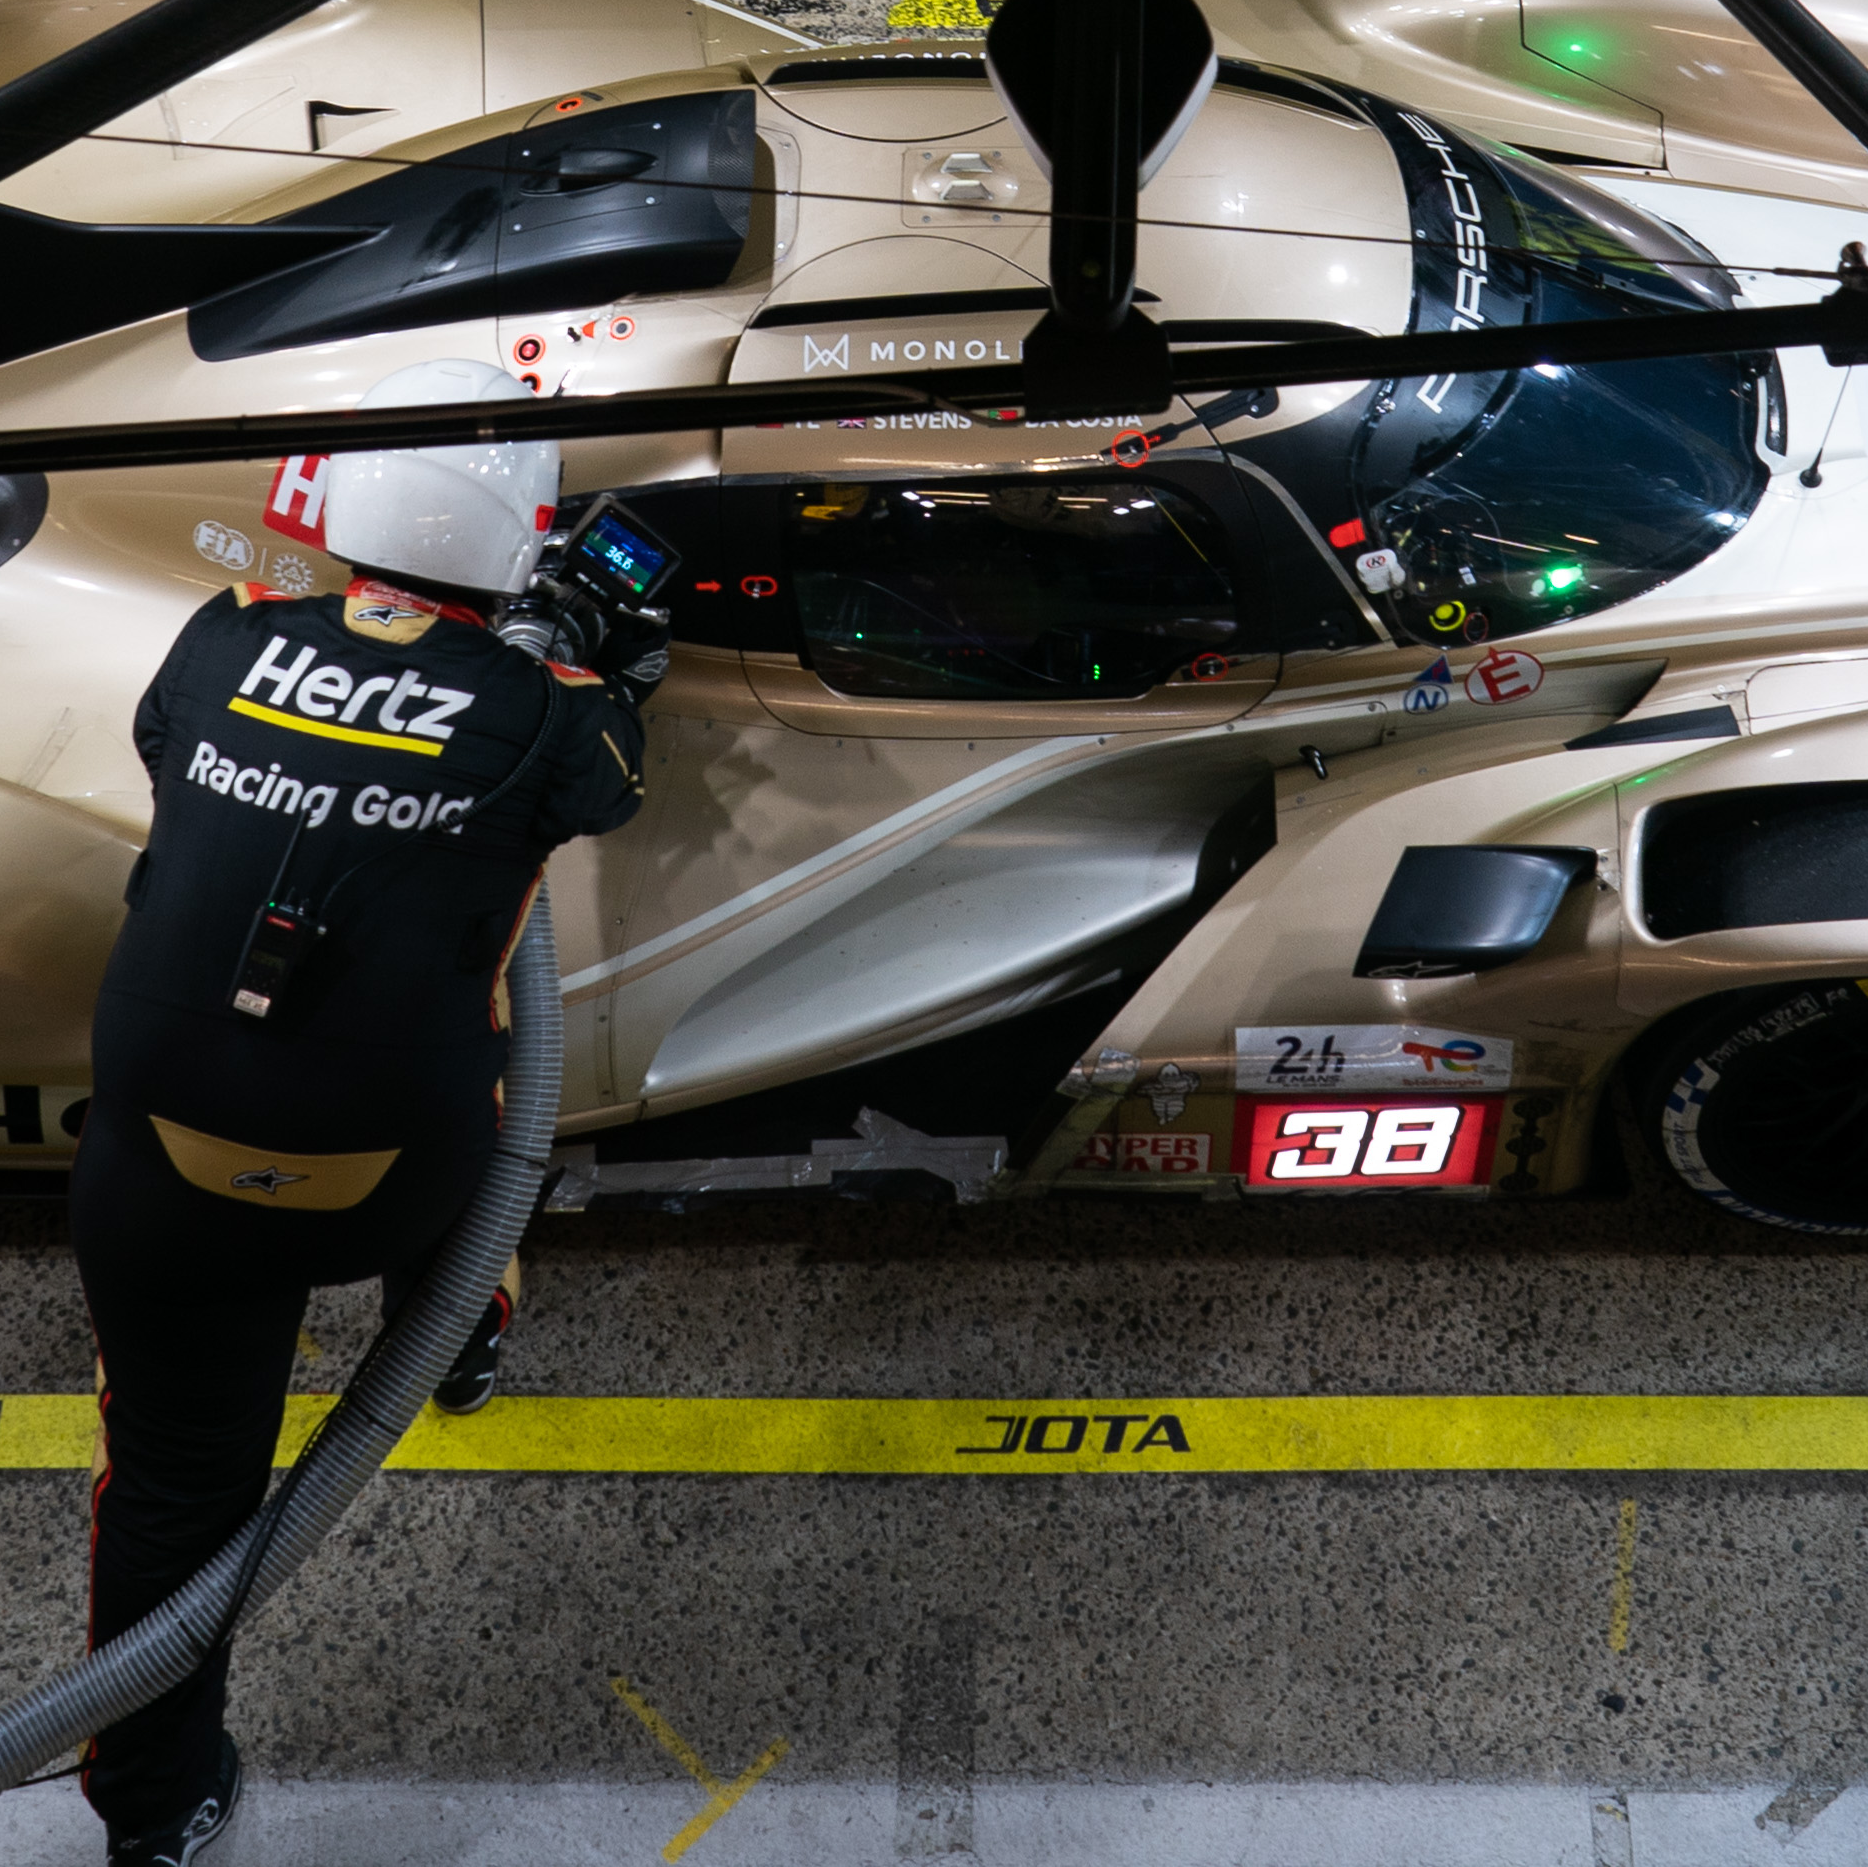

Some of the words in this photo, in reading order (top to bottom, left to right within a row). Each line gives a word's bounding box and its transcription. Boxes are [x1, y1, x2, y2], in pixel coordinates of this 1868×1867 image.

[1397, 110, 1488, 414] PRSCHE
[873, 412, 973, 430] STEVENS
[238, 635, 476, 741] Hertz
[186, 740, 339, 828] Racing
[351, 784, 475, 834] Gold
[1266, 1074, 1287, 1084] LE
[1289, 1074, 1343, 1085] MANS
[1266, 1105, 1462, 1180] 38
[955, 1414, 1192, 1455] JOTA
